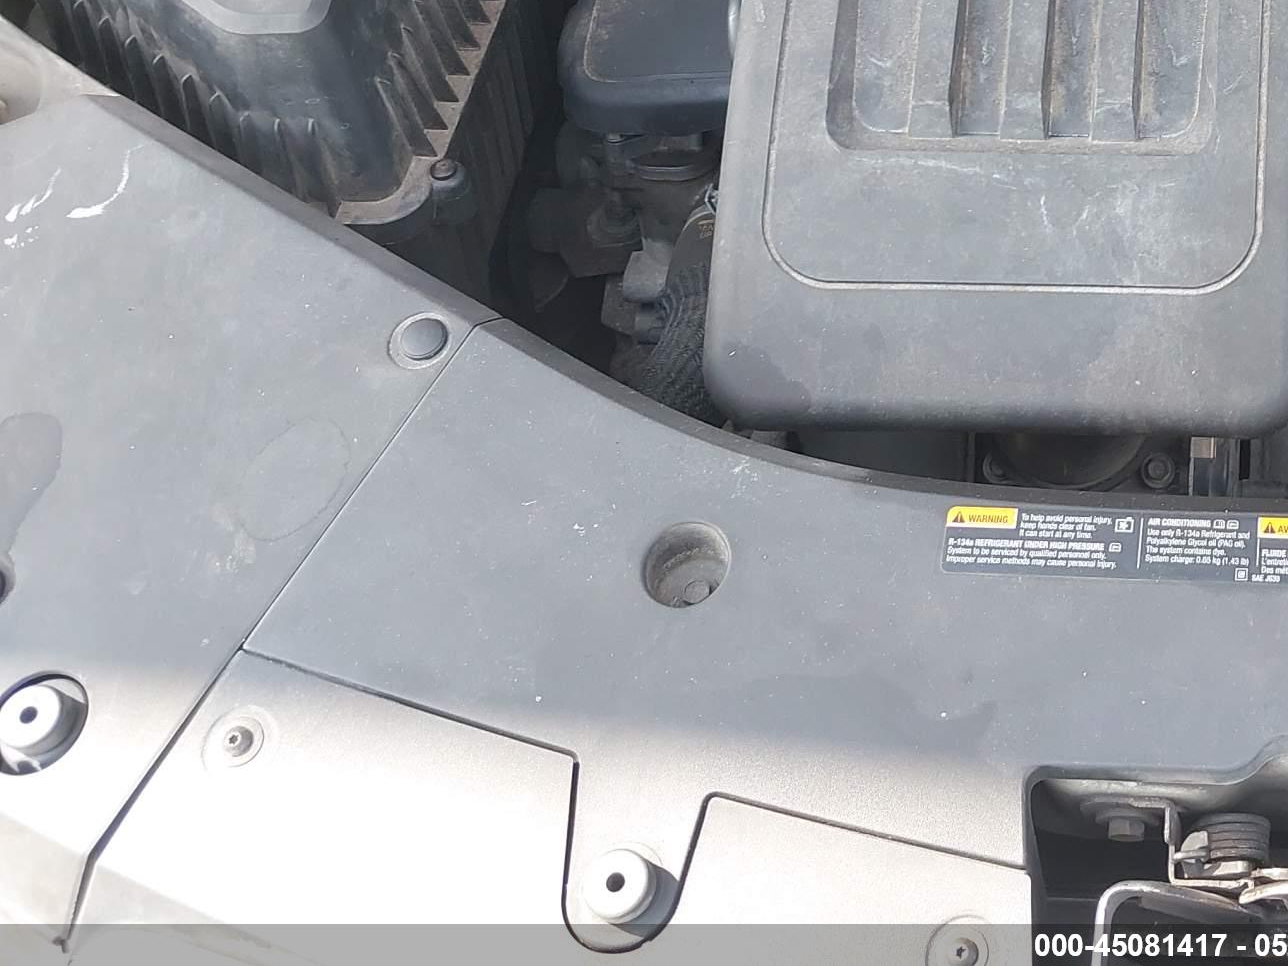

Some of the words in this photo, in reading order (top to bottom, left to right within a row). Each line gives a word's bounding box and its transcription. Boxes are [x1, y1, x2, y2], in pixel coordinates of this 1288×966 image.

[968, 514, 1008, 523] WARNING
[1031, 514, 1044, 522] help
[1064, 516, 1092, 524] personal
[1162, 518, 1211, 527] CONDITIONING
[1161, 529, 1174, 538] only
[1176, 529, 1200, 537] R-134a
[1201, 530, 1236, 539] Refrigerant
[948, 538, 974, 546] R-134a
[975, 539, 1023, 547] REFRIGERANT
[1024, 540, 1048, 548] UNDER
[1050, 541, 1067, 550] HIGH
[1068, 542, 1105, 551] PRESSURE
[1146, 537, 1186, 546] Polyalkylene
[1188, 538, 1207, 546] Glycol
[1218, 539, 1233, 548] (PAG
[947, 546, 971, 555] System
[973, 547, 979, 555] to
[991, 548, 1018, 556] serviced
[1020, 549, 1027, 557] by
[1029, 550, 1057, 558] qualified
[1058, 551, 1090, 559] personnel
[1159, 546, 1183, 554] system
[1262, 549, 1286, 557] FLUIDE
[946, 555, 976, 564] Improper
[1002, 557, 1030, 565] methods
[1031, 559, 1045, 567] may
[1067, 560, 1096, 568] personal
[1145, 555, 1169, 563] System
[1212, 557, 1221, 566] kg
[1240, 558, 1249, 566] lb)
[1261, 566, 1273, 574] Des
